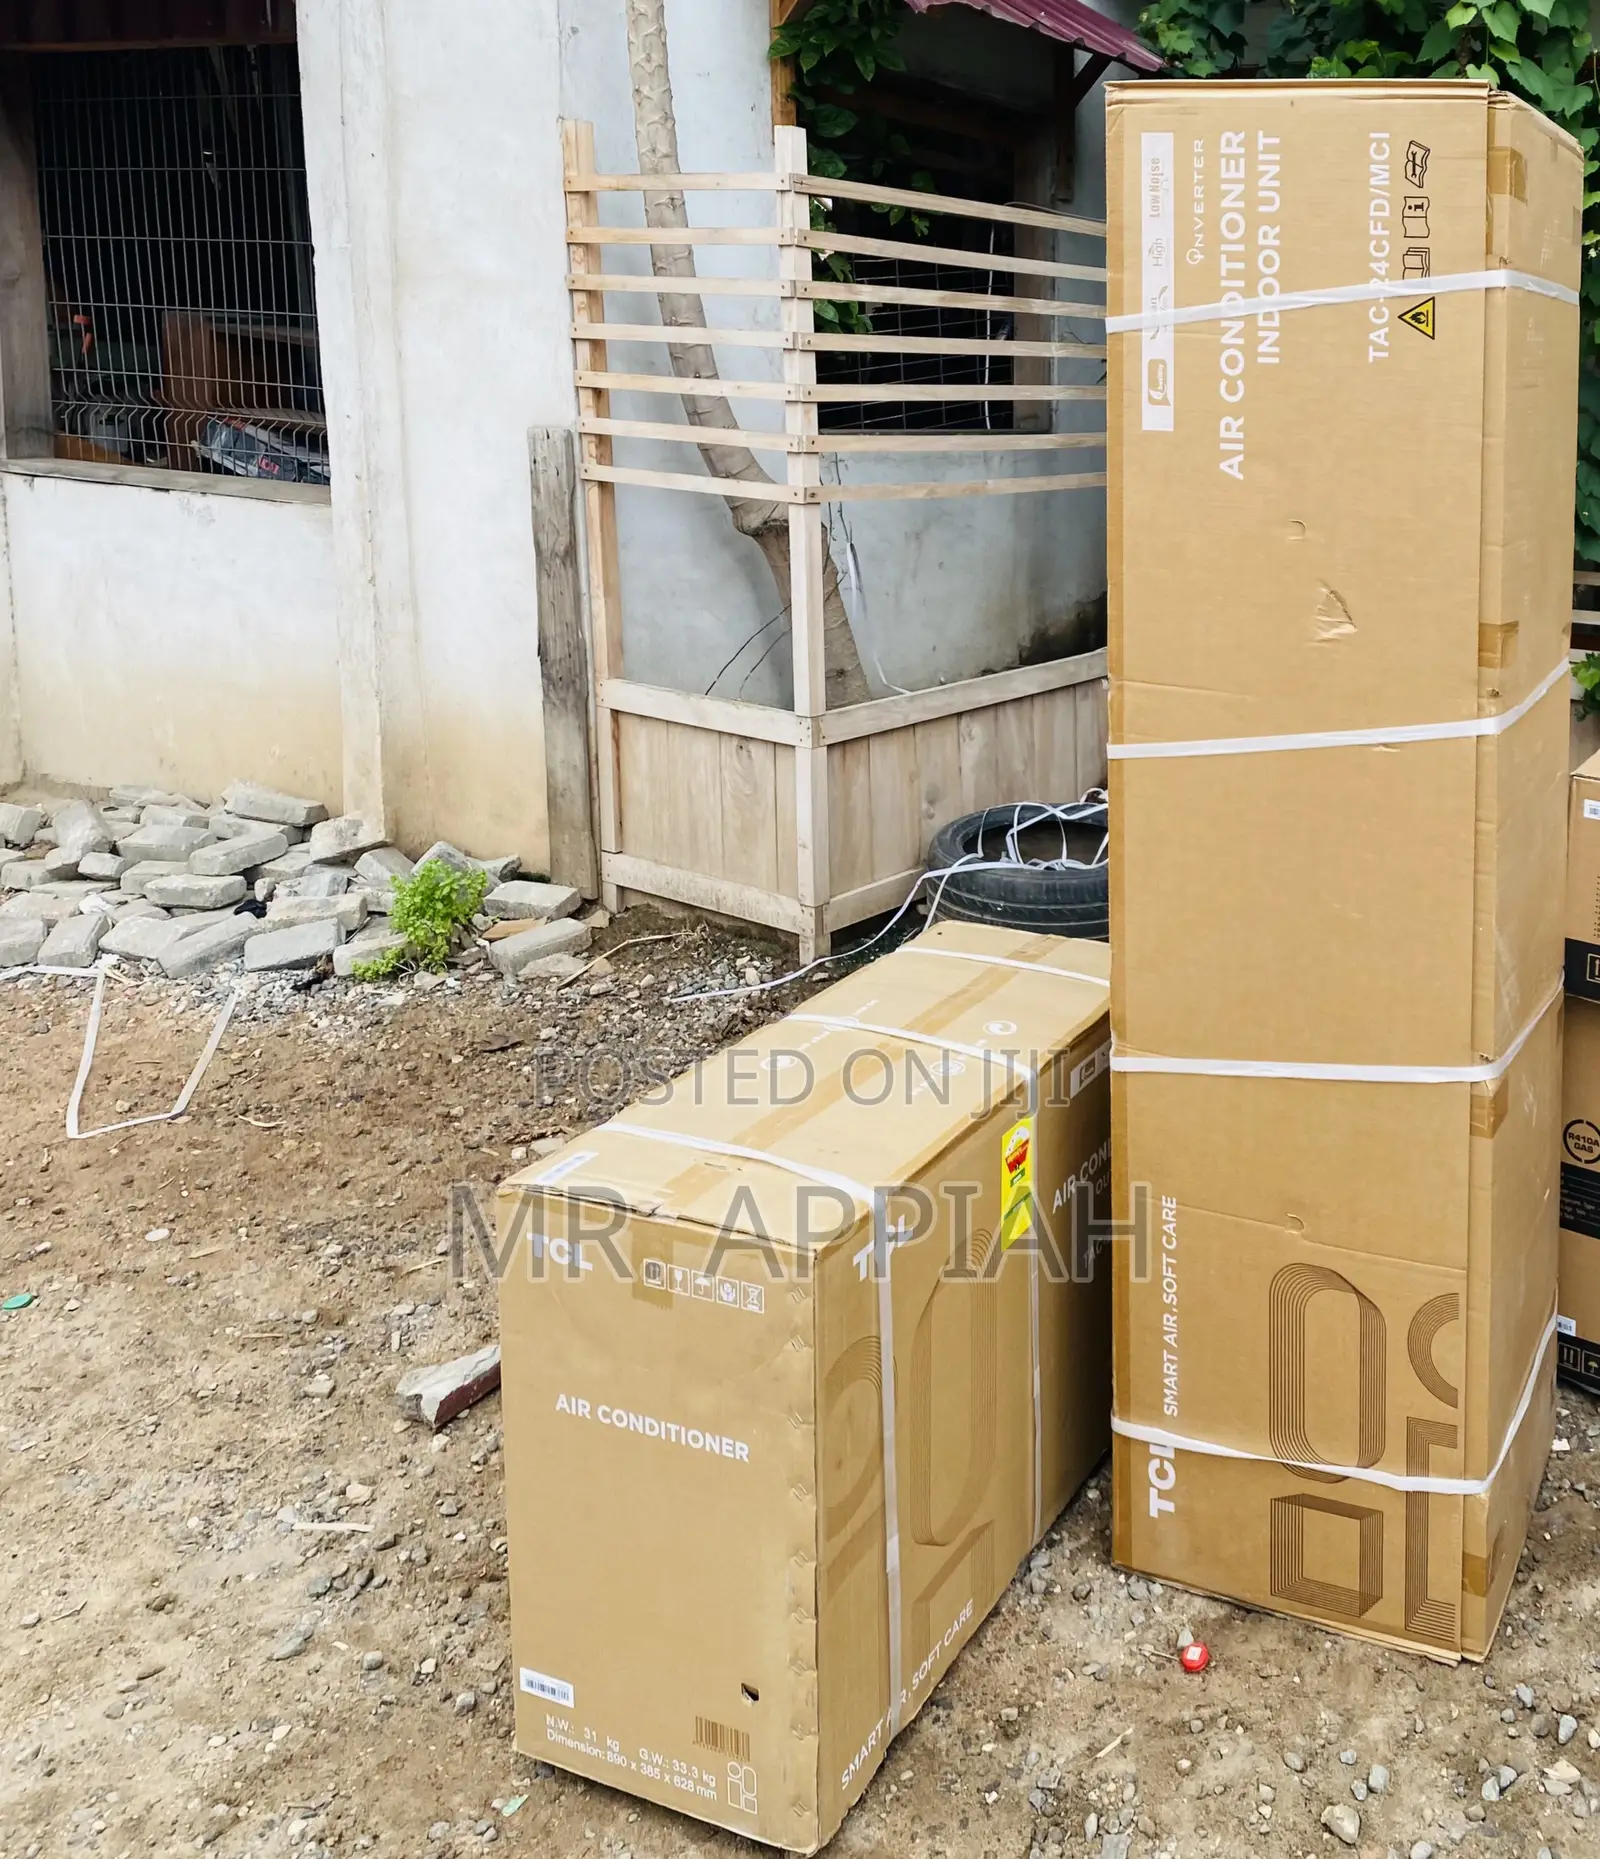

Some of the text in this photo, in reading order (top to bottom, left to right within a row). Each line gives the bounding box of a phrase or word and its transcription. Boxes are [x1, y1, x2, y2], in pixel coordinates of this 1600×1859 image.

[1149, 194, 1161, 218] Low
[1257, 130, 1281, 364] INDOOR UNIT
[1219, 130, 1246, 481] AIR CONDITIONER
[1573, 1142, 1594, 1154] GAS
[1052, 1174, 1077, 1215] AIR
[1161, 1195, 1177, 1250] CARE
[526, 1232, 594, 1271] TCL
[1163, 1349, 1178, 1418] SMART
[555, 1393, 750, 1465] AIR CONDITIONER
[841, 1719, 884, 1791] SMART
[912, 1641, 943, 1691] SOFT
[944, 1598, 974, 1648] CARE
[546, 1729, 606, 1759] Dimension:
[639, 1763, 661, 1781] 385
[673, 1776, 695, 1794] 628
[695, 1784, 718, 1803] mm
[583, 1727, 597, 1743] 31
[606, 1736, 620, 1754] kg
[672, 1759, 700, 1780] 33.3
[702, 1769, 717, 1788] kg
